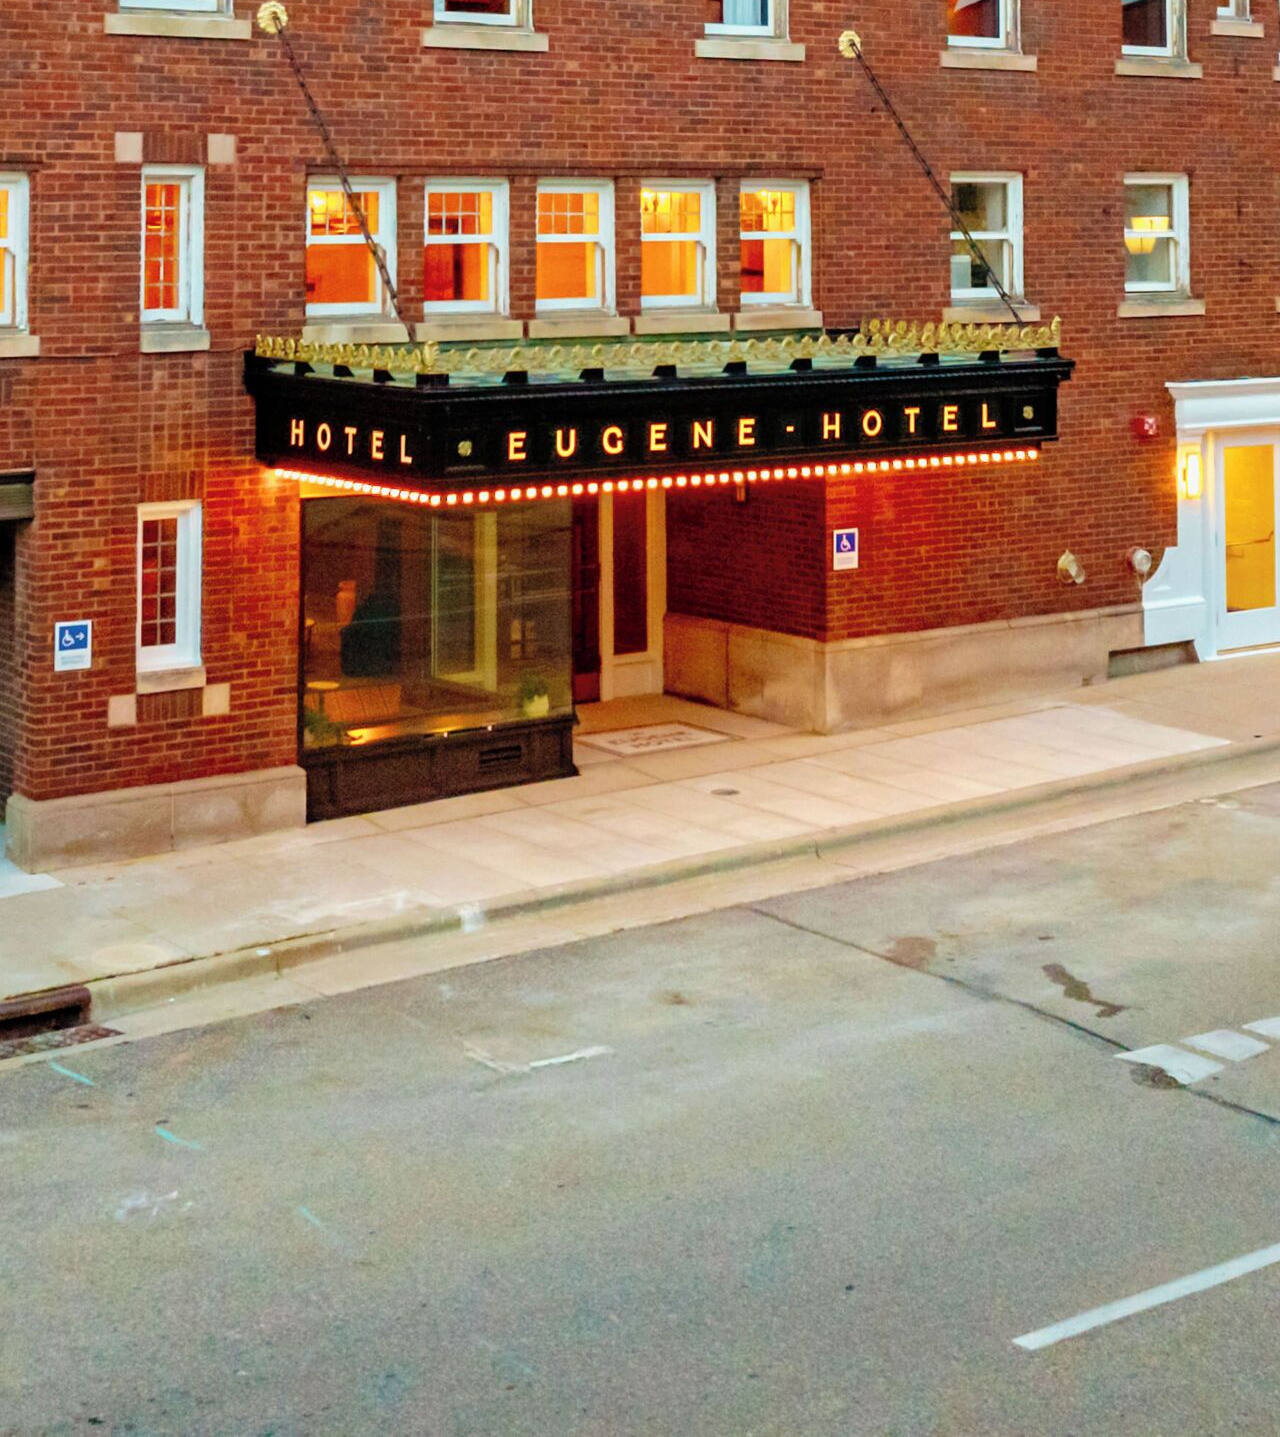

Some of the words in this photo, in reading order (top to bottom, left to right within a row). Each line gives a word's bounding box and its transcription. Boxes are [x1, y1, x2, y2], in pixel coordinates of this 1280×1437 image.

[290, 419, 412, 464] HOTEL
[507, 418, 756, 460] EUGENE
[822, 403, 997, 439] HOTEL
